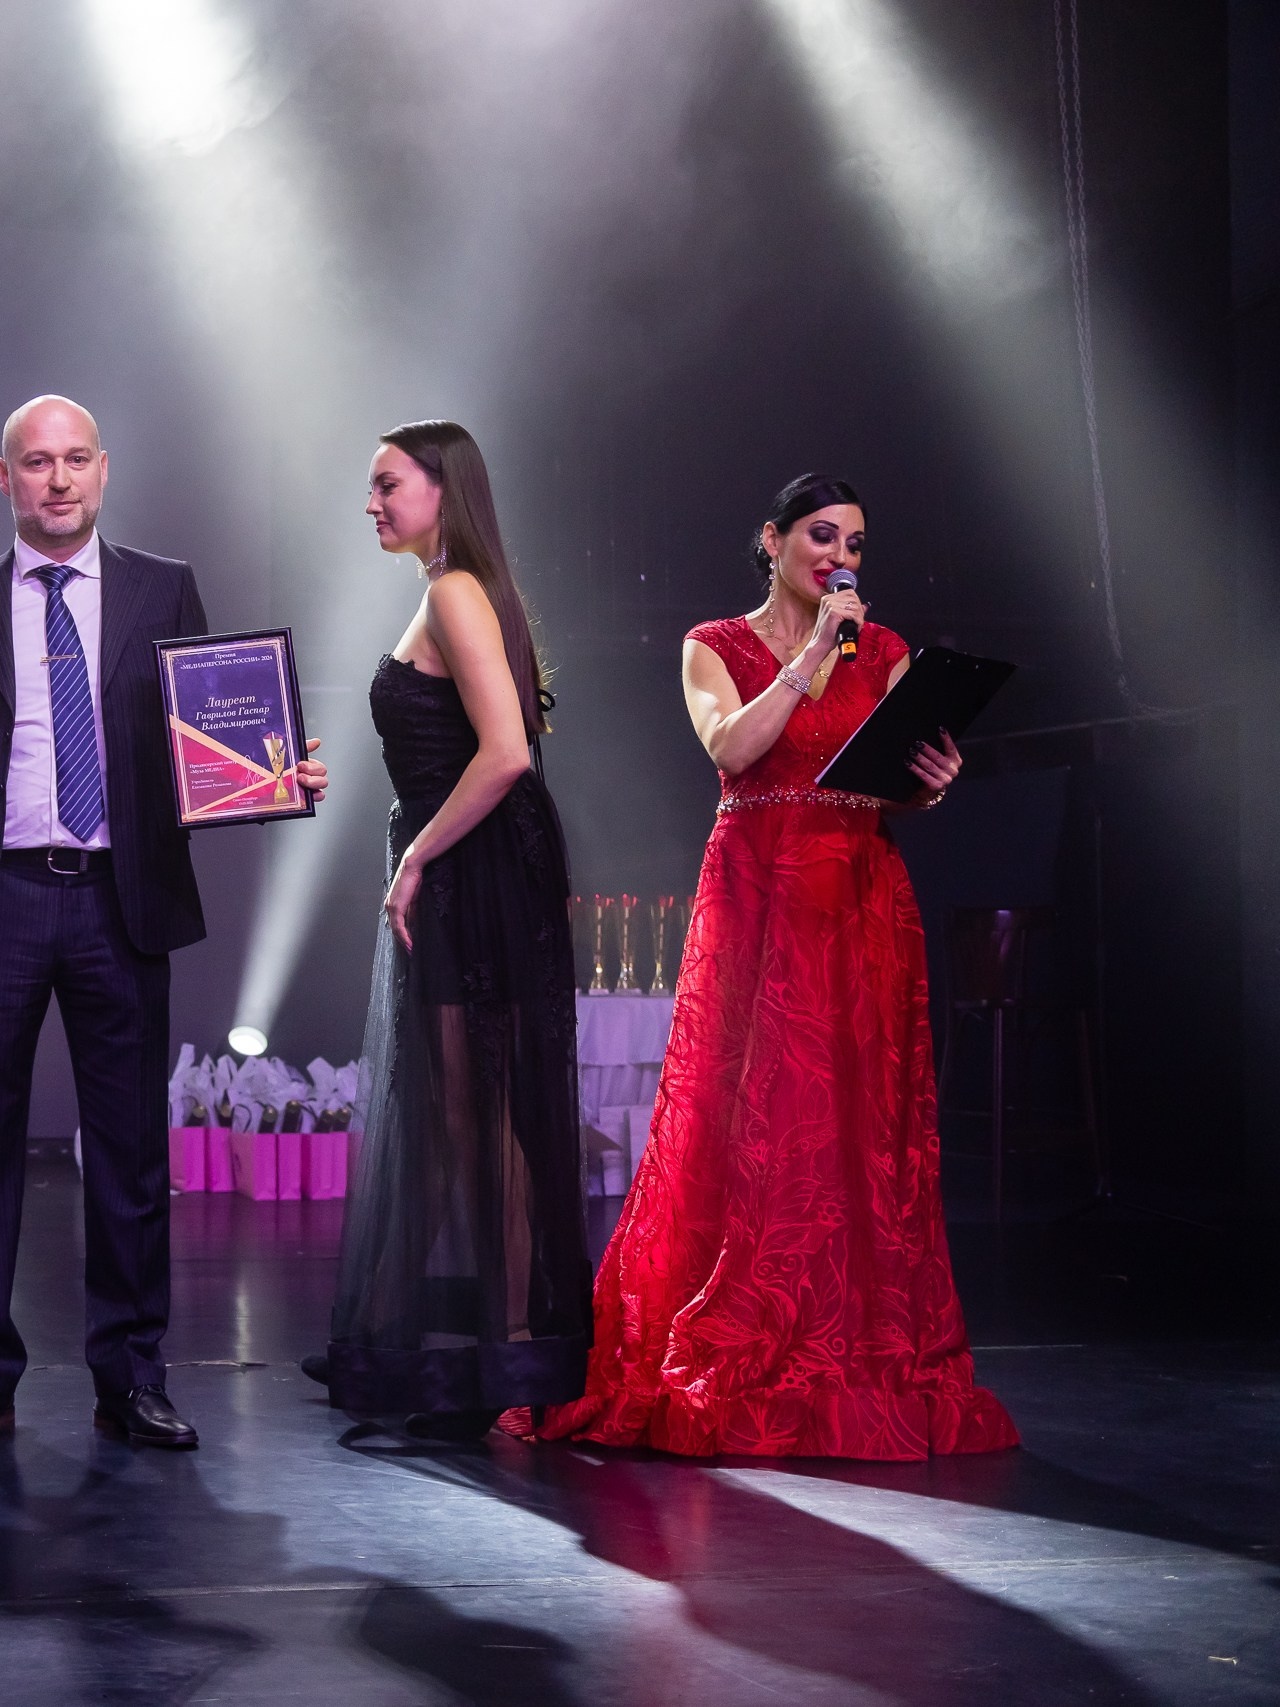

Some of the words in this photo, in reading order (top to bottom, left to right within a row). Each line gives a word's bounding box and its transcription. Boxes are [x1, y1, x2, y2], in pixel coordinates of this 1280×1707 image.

[205, 695, 257, 709] Лауреат
[195, 710, 237, 721] Гаврилов
[238, 706, 270, 716] Гаспар
[201, 717, 267, 731] Владимирович
